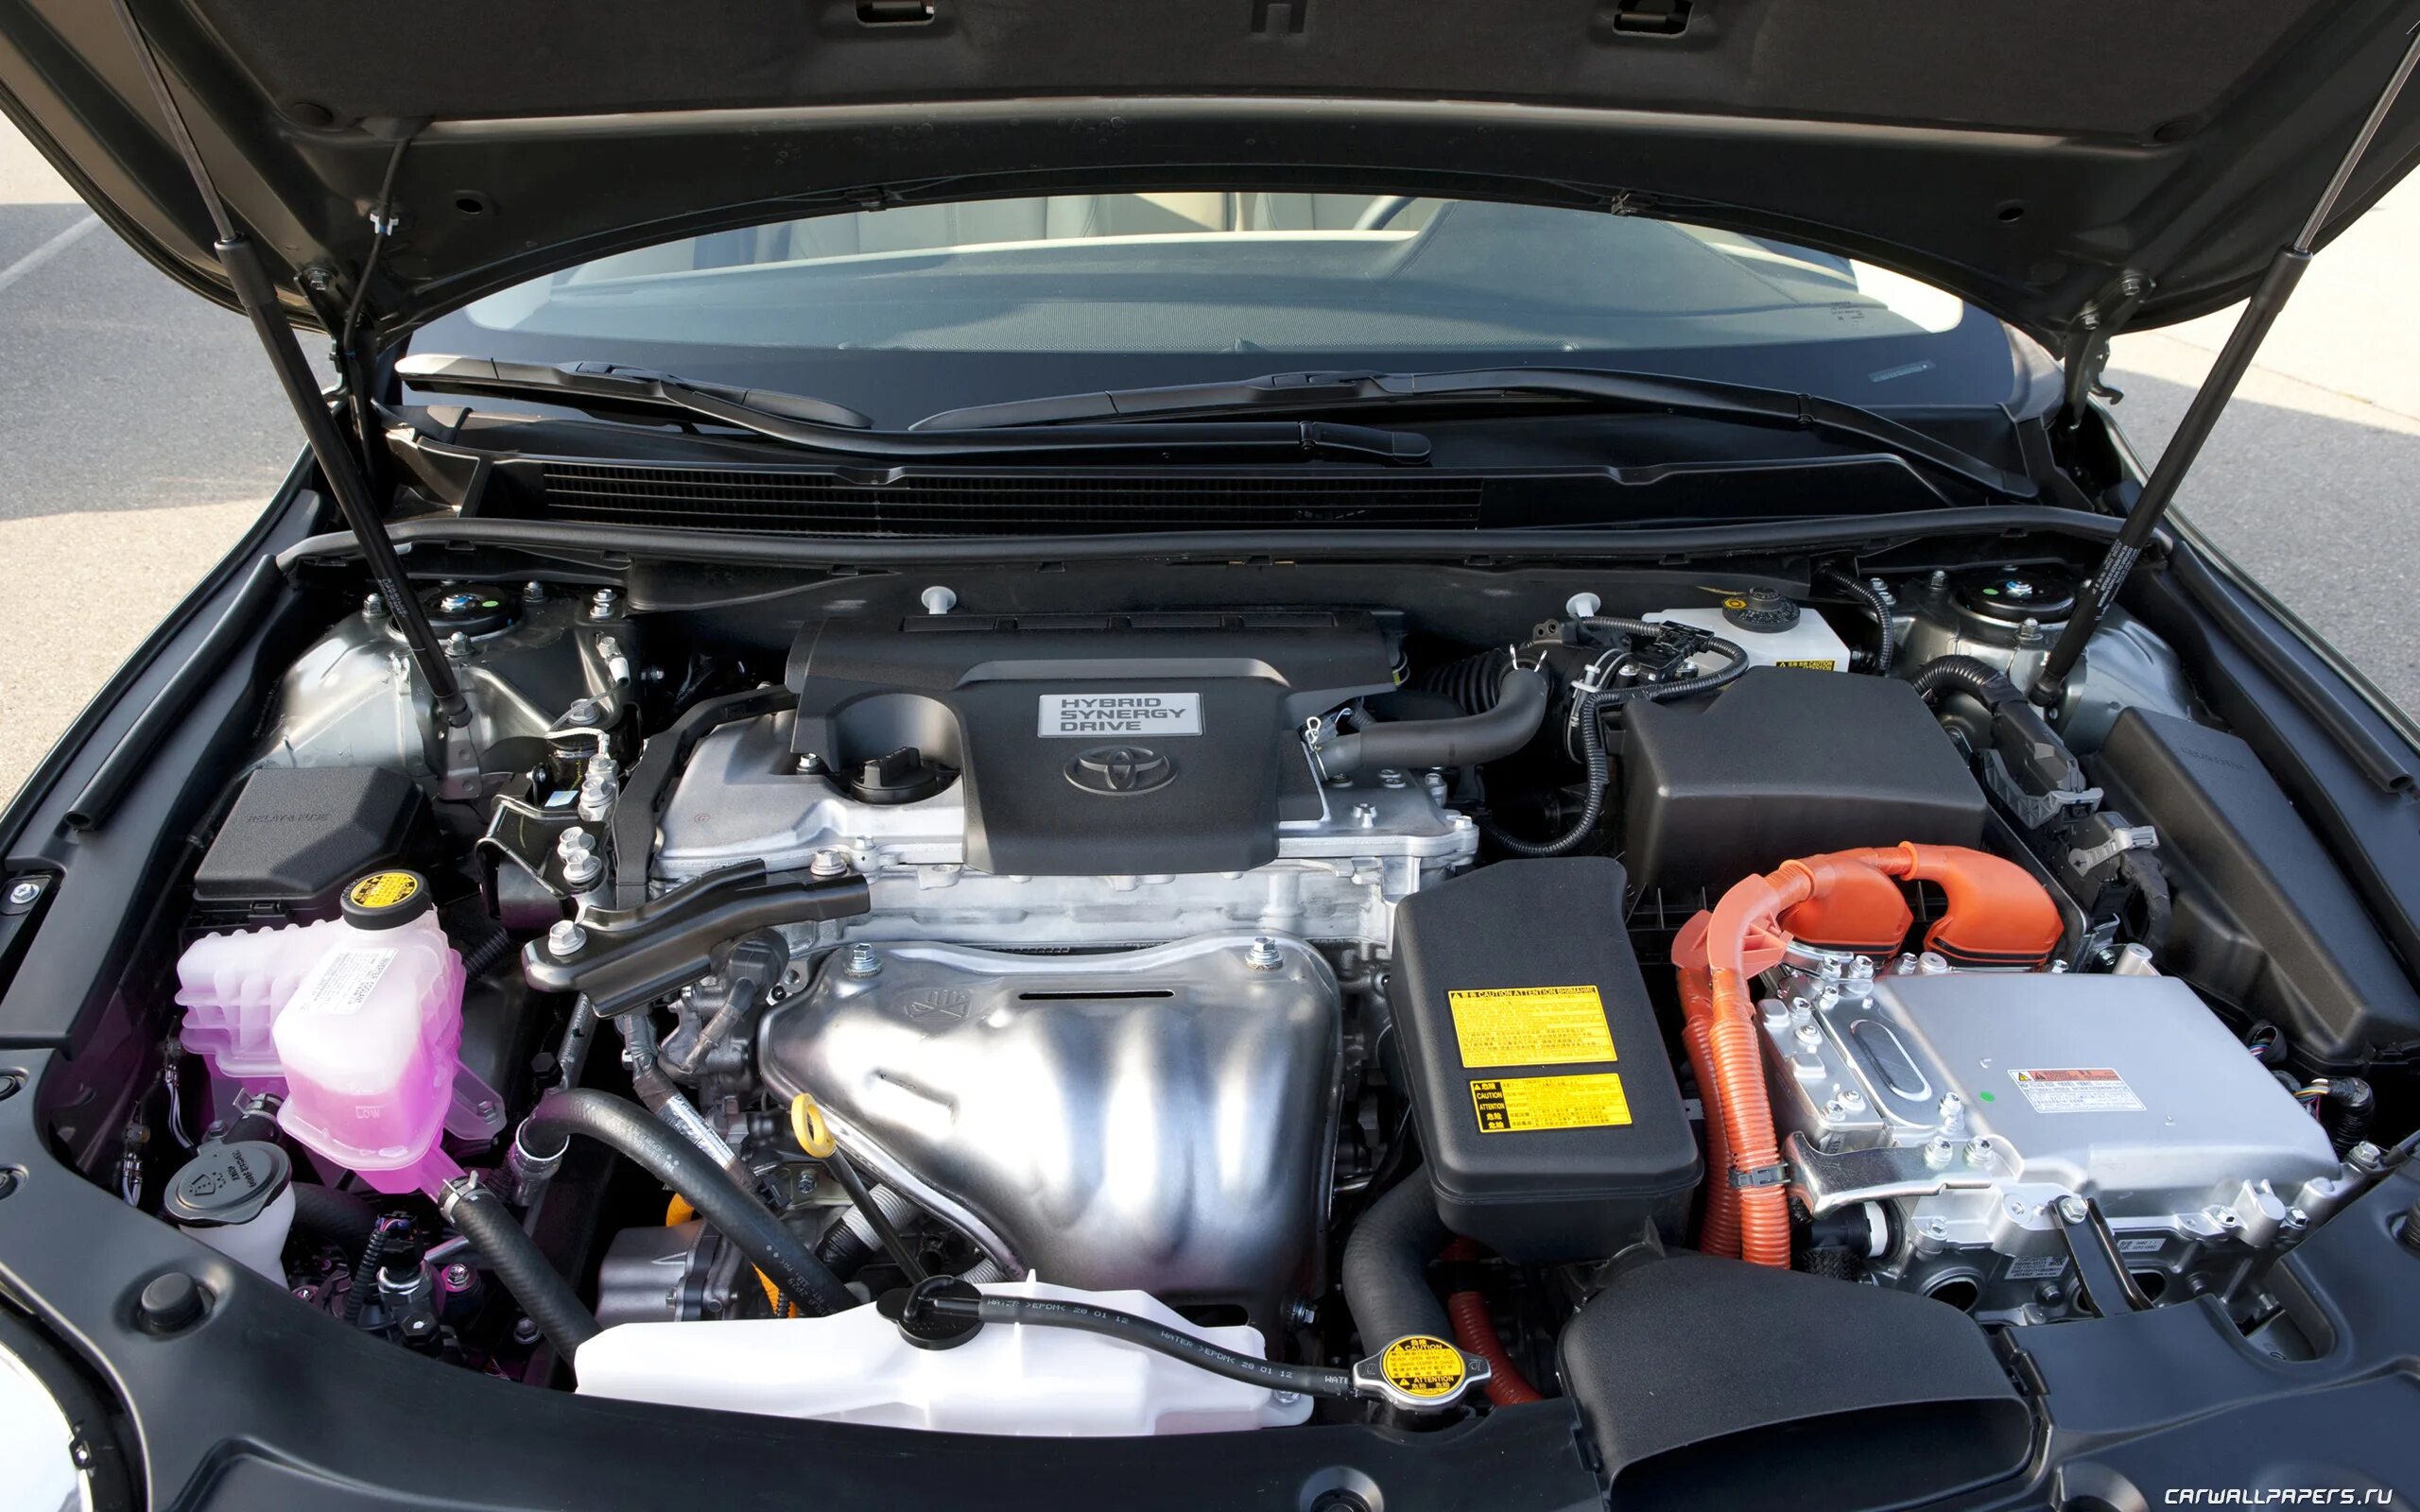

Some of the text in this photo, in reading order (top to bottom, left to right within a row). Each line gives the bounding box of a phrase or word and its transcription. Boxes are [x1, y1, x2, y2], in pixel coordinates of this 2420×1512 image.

[1062, 698, 1161, 708] HYBRID
[1061, 709, 1185, 719] SYNERGY
[1061, 721, 1141, 731] DRIVE
[355, 1108, 380, 1119] LOW
[1161, 1331, 1194, 1349] WATER
[1280, 1370, 1293, 1379] 12
[1324, 1375, 1348, 1384] WATE
